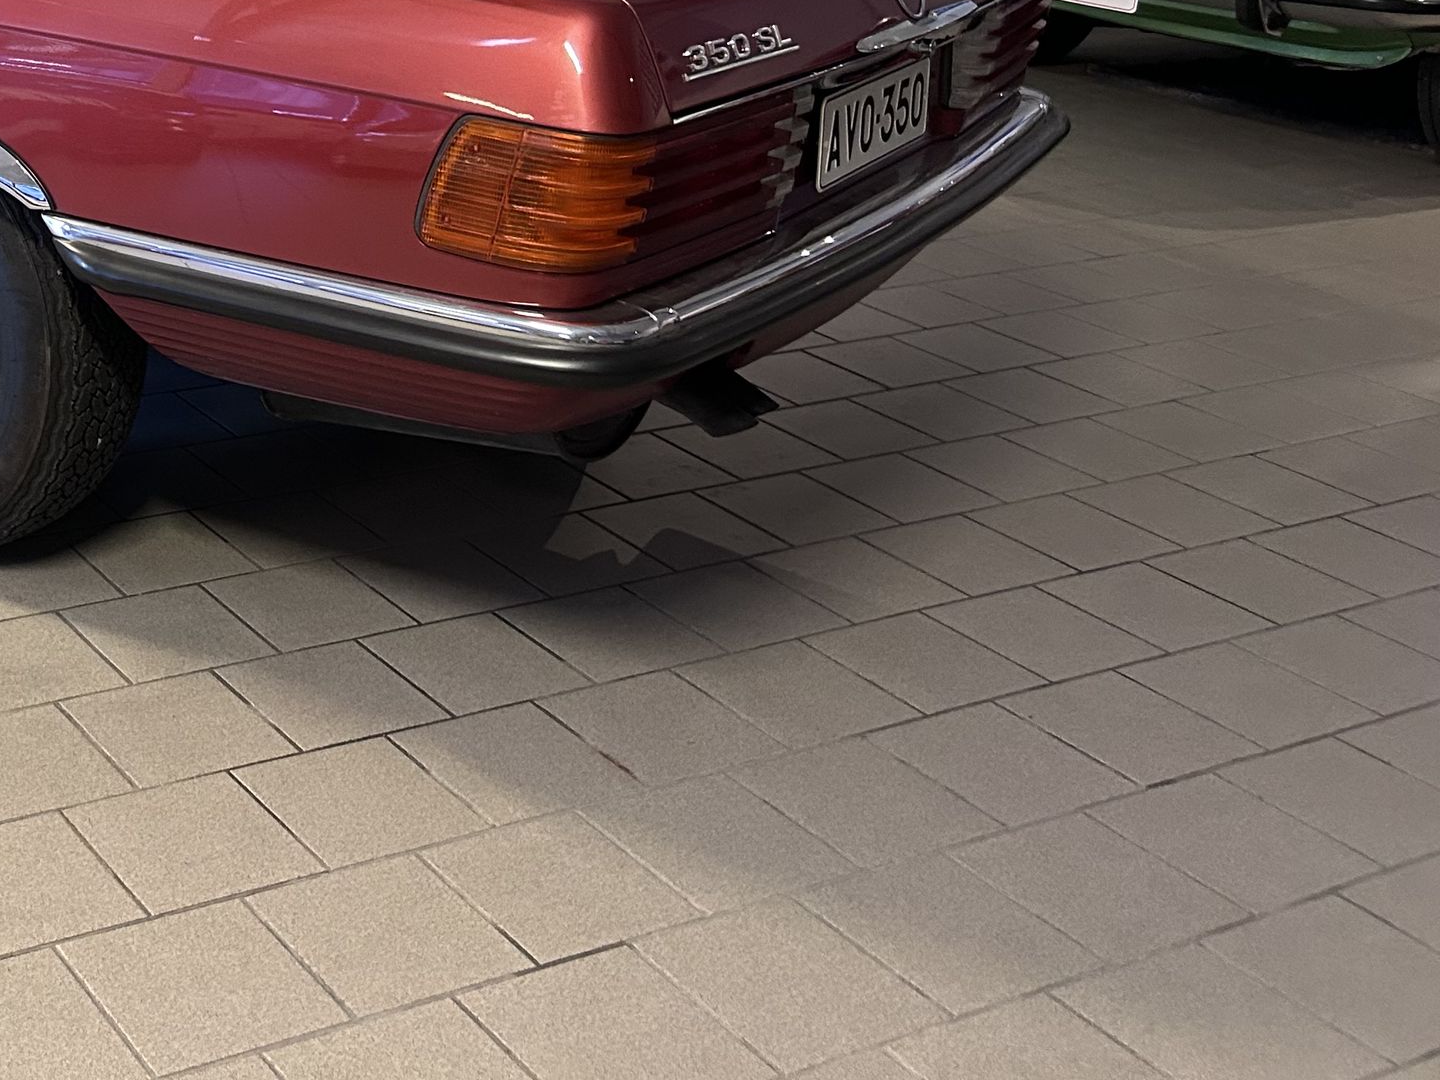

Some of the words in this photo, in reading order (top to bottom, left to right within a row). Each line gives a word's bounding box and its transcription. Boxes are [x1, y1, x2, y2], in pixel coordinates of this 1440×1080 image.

[682, 33, 751, 71] 350
[752, 25, 792, 53] SL
[825, 72, 925, 173] AVO-350
